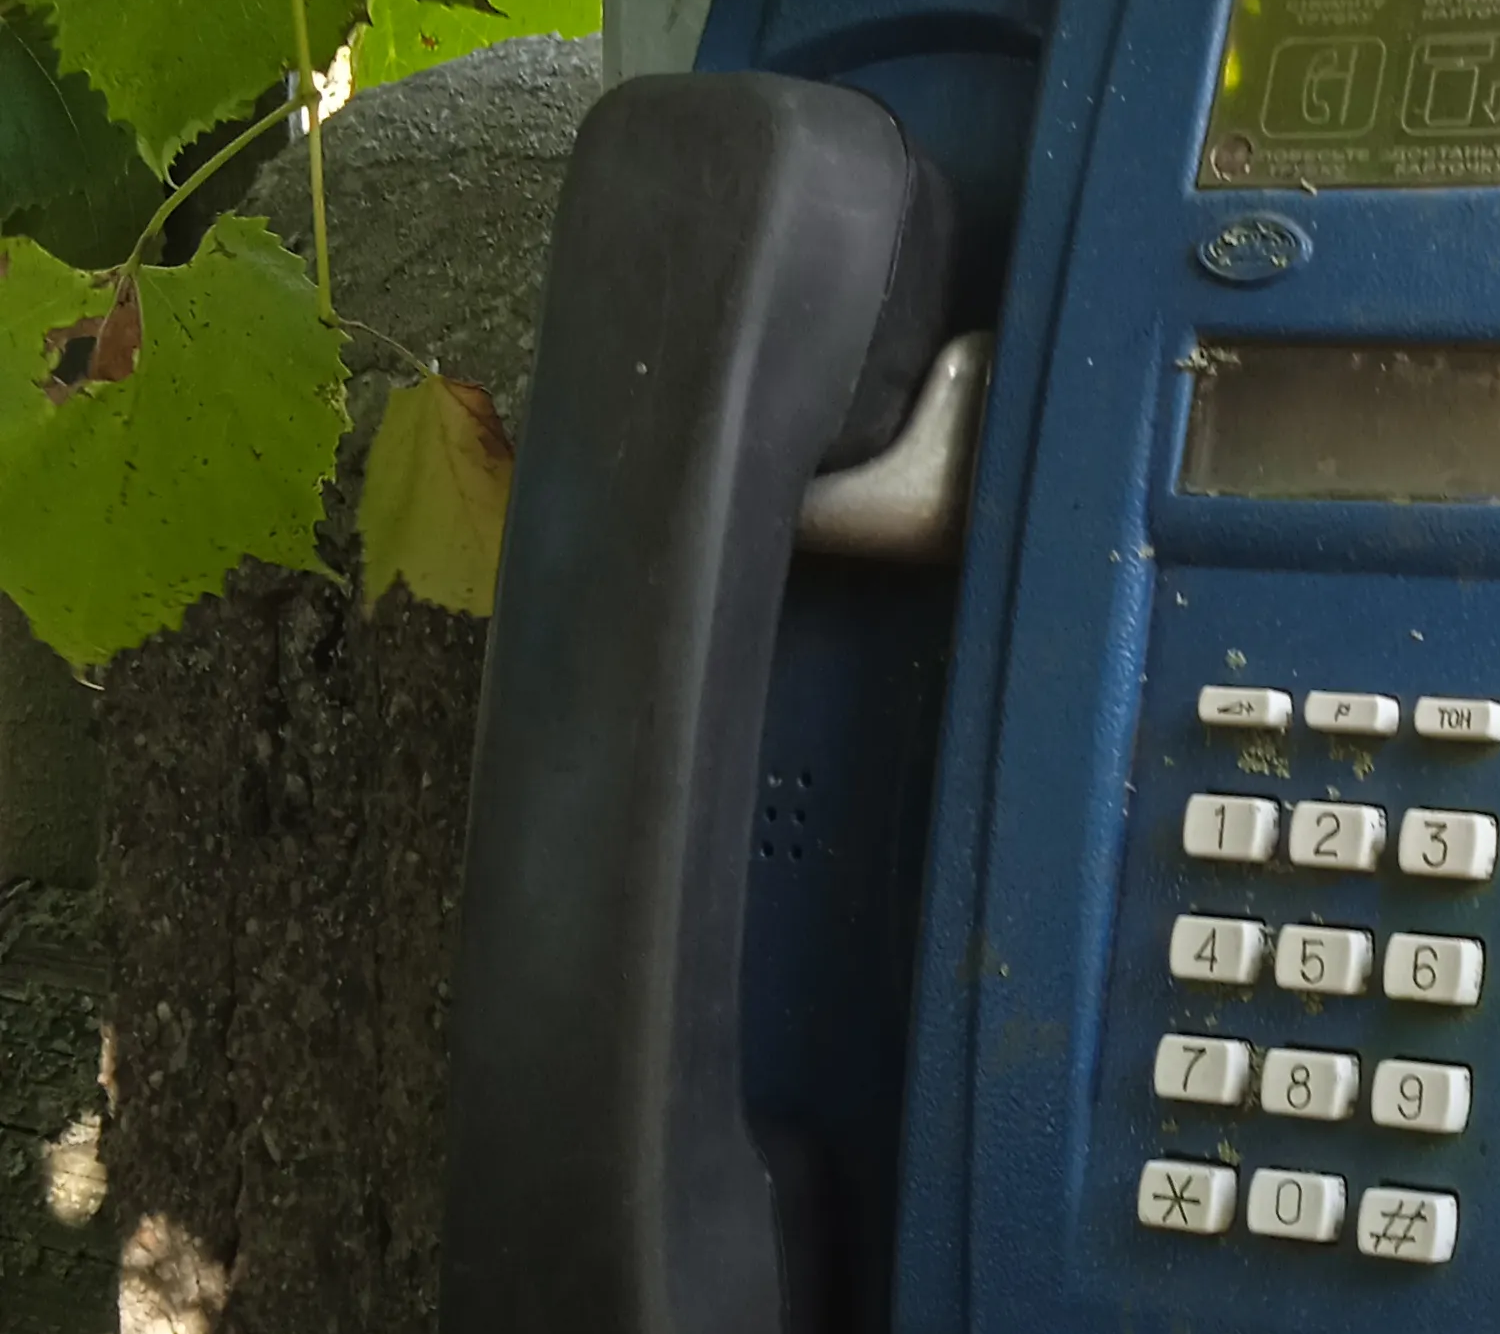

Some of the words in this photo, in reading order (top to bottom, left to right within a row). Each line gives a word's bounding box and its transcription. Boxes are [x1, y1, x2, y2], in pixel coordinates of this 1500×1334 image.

[1437, 707, 1473, 731] ТОН
[1214, 805, 1227, 850] 1
[1313, 812, 1341, 859] 2
[1421, 822, 1449, 868] 3
[1192, 927, 1219, 974] 4
[1299, 938, 1325, 985] 5
[1411, 945, 1438, 992] 6
[1181, 1045, 1207, 1093] 7
[1285, 1064, 1312, 1110] 8
[1397, 1074, 1424, 1121] 9
[1275, 1179, 1303, 1225] 0
[1368, 1200, 1429, 1255] #
